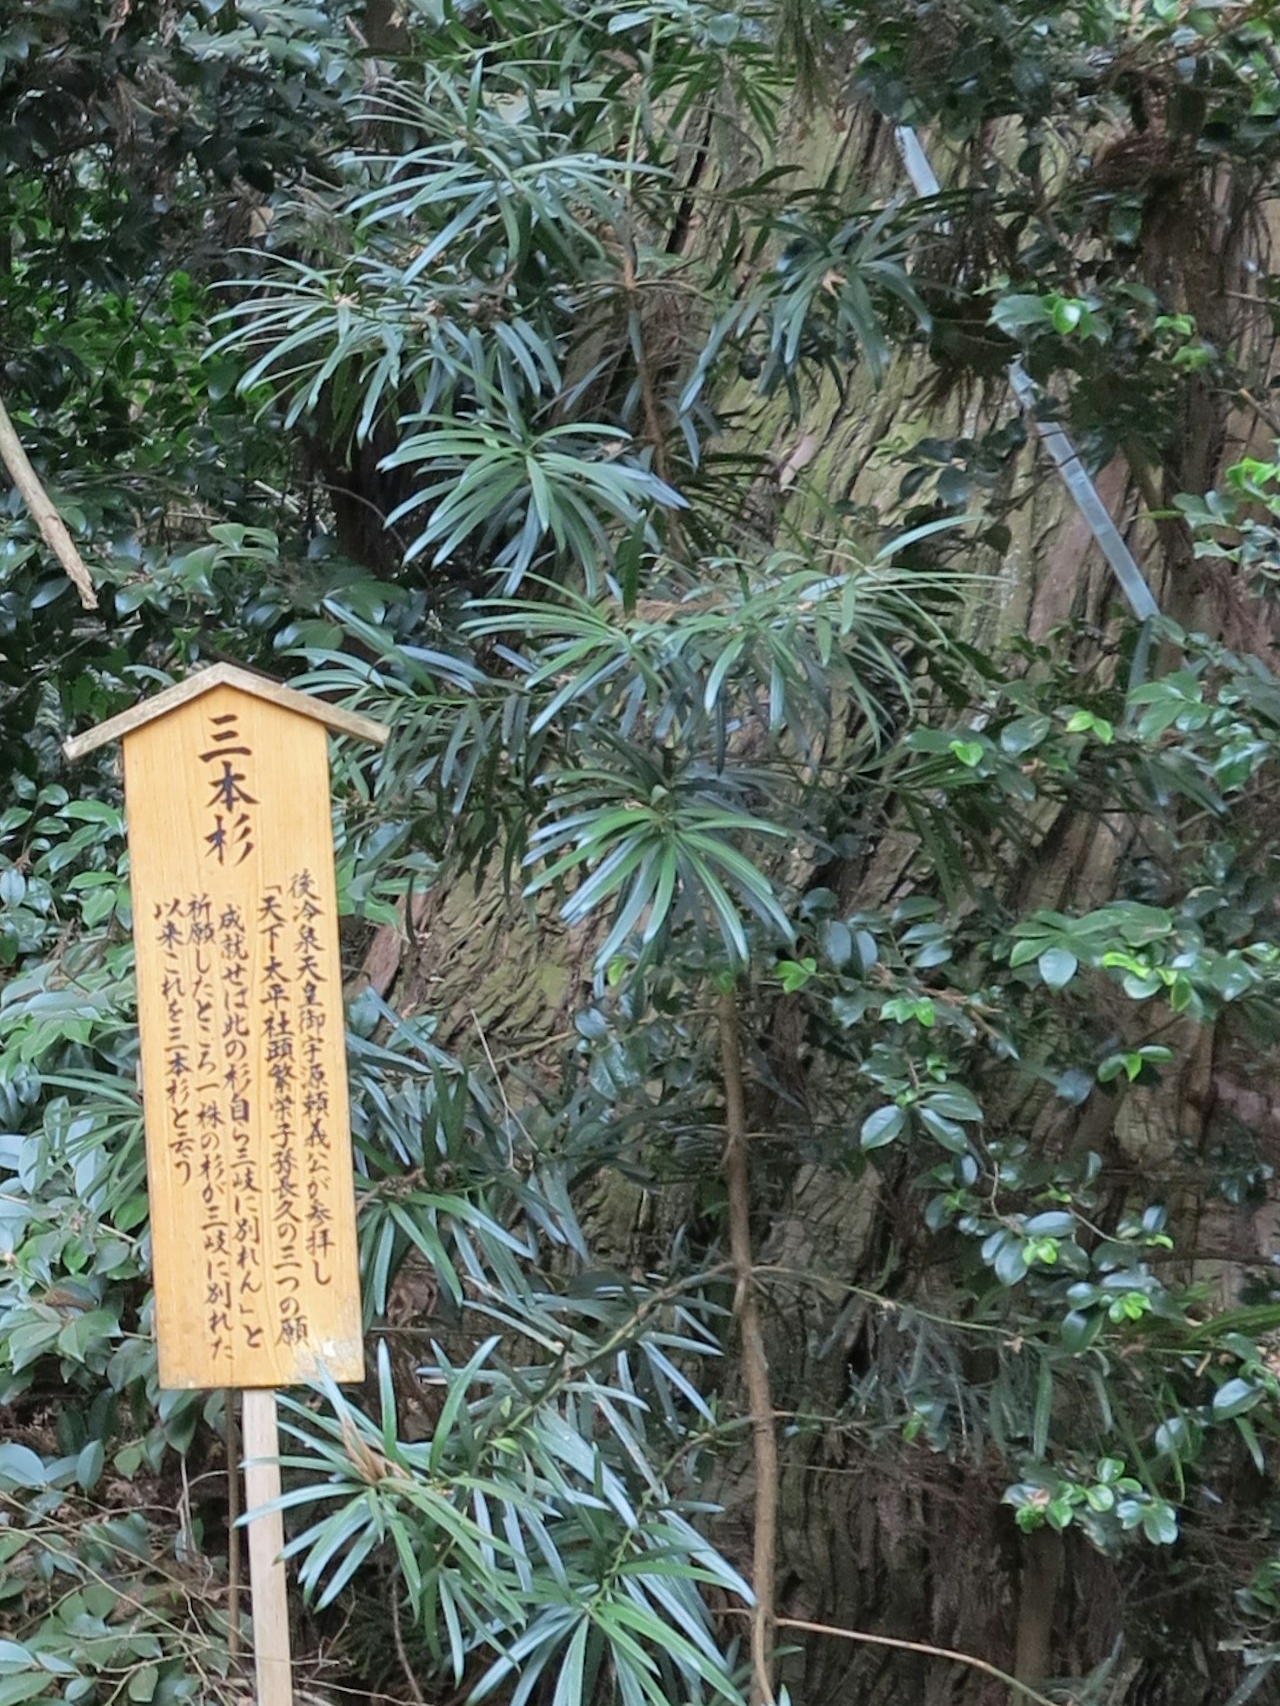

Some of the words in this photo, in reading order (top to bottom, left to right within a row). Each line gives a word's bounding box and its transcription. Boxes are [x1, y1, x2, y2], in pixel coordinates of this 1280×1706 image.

[198, 713, 260, 867] 三本杉
[153, 898, 195, 1187] 以来これを三本杉と云う
